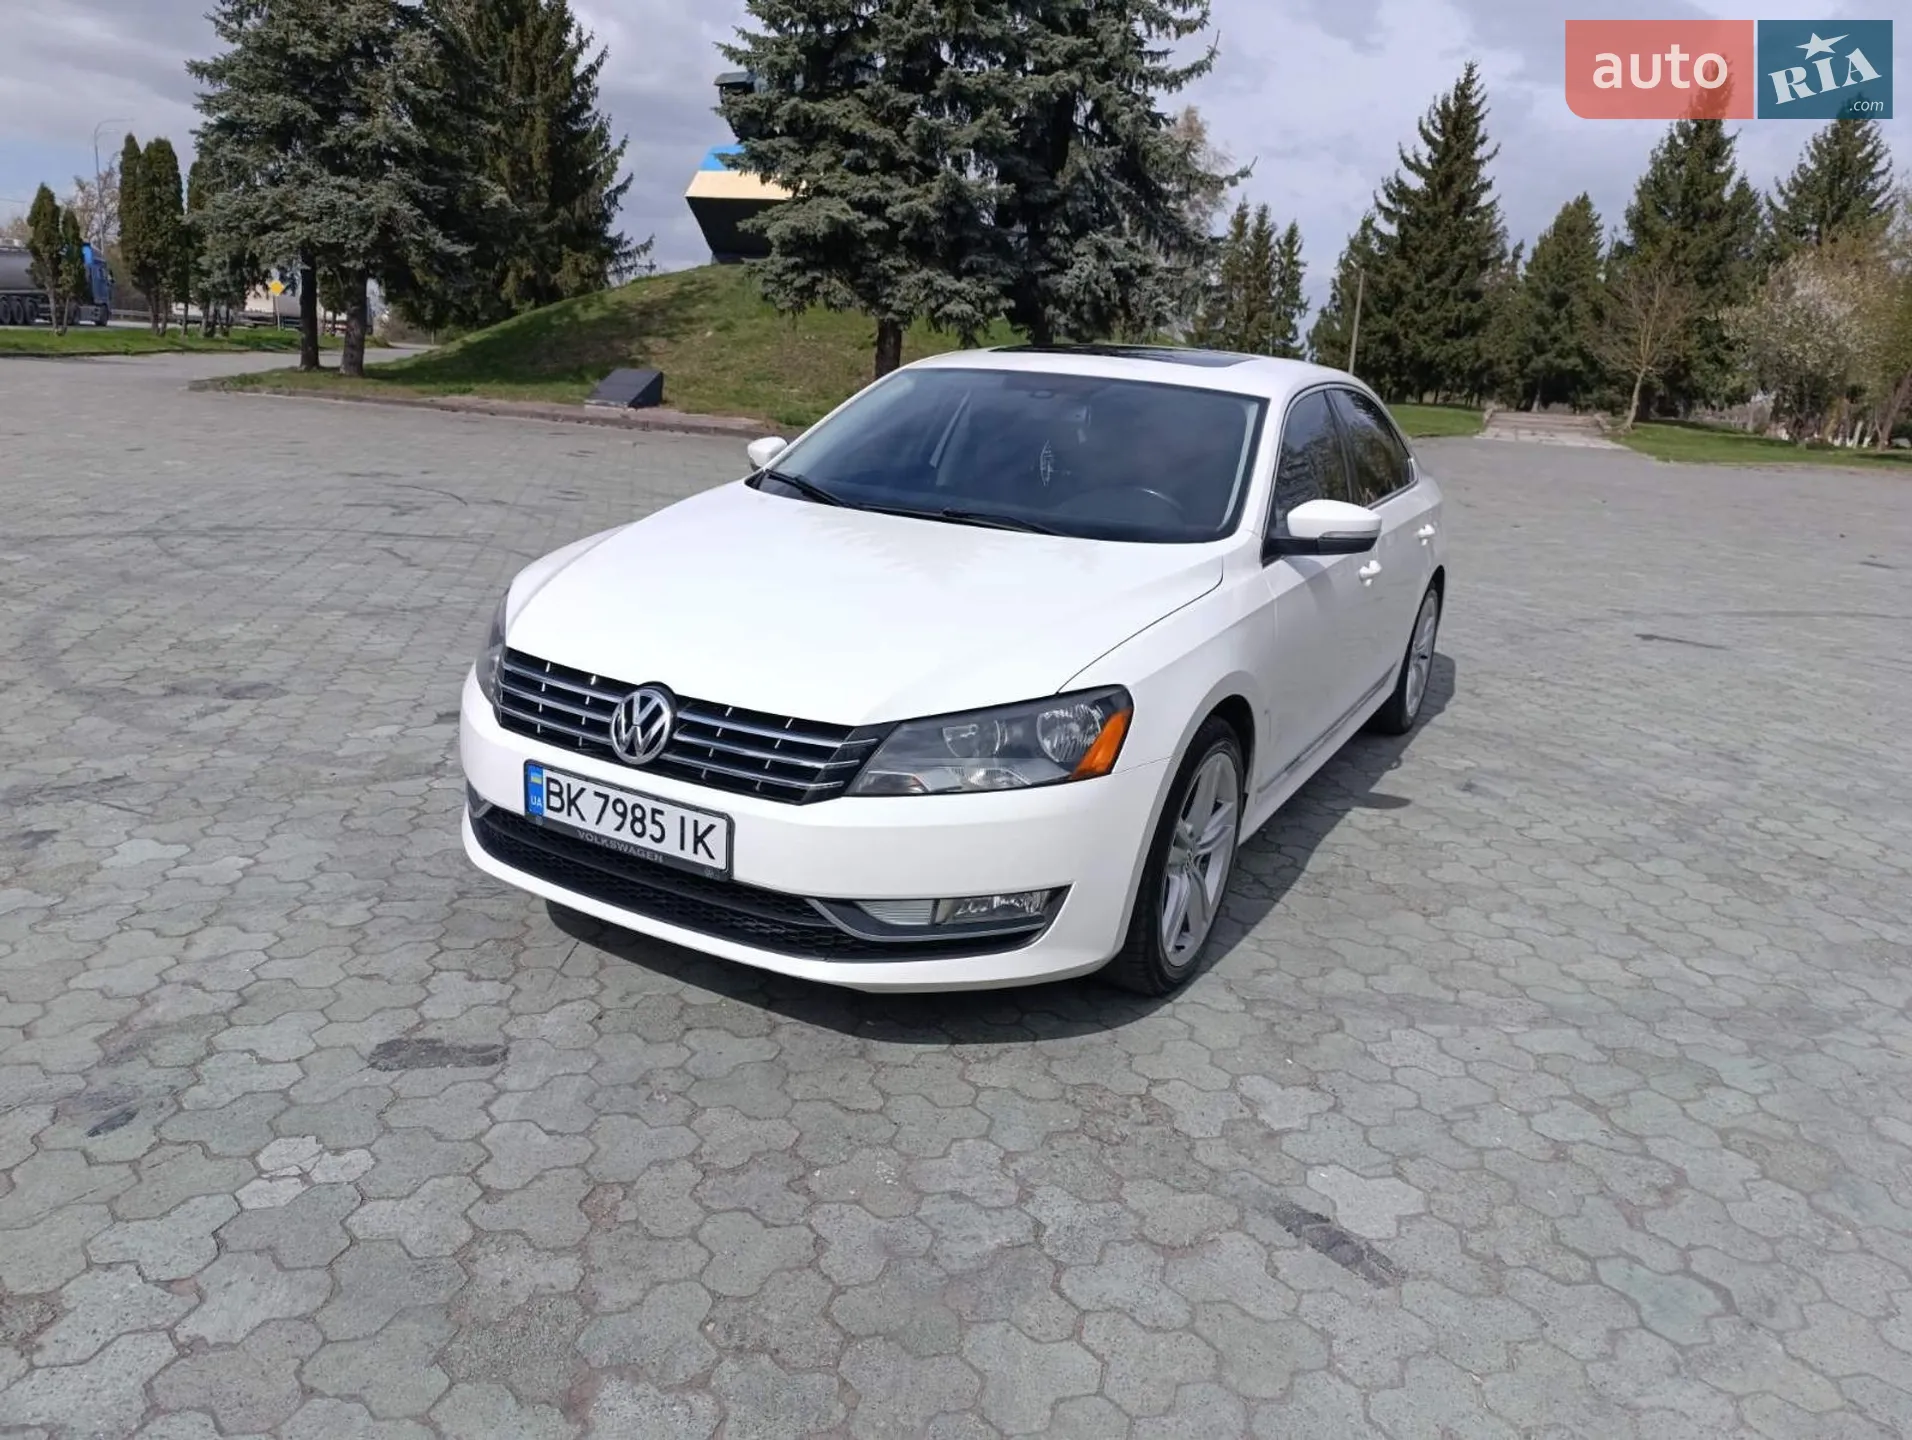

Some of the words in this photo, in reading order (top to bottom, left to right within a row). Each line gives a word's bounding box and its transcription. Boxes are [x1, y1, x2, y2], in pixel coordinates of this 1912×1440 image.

[530, 796, 543, 808] UA
[545, 776, 587, 822] BK
[593, 791, 666, 844] 7985
[679, 816, 716, 860] IK
[577, 830, 664, 863] VOLKSWAGEN
